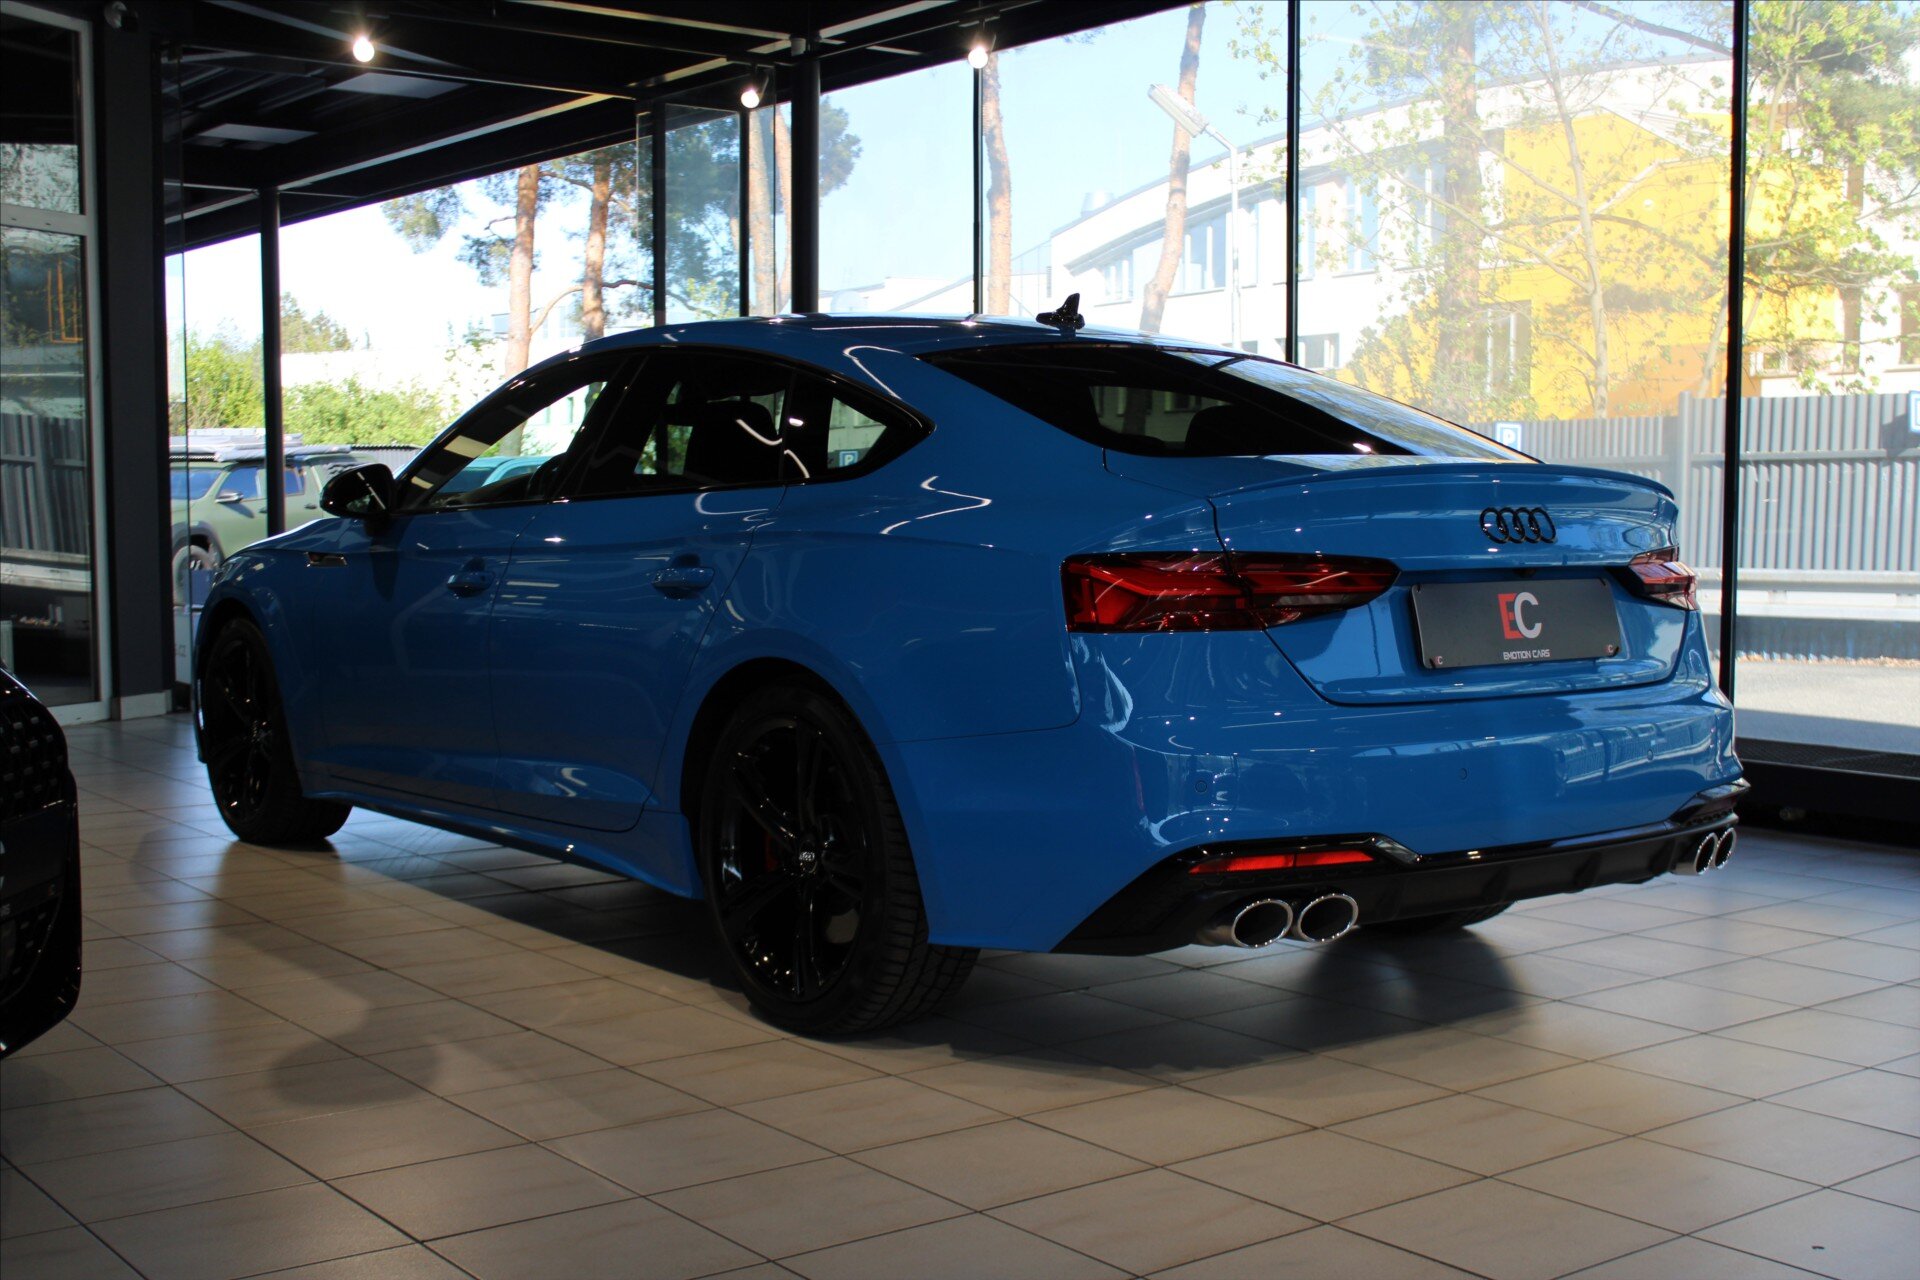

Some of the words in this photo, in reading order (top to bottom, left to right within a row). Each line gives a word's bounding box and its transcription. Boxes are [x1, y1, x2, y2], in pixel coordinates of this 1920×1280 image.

[1502, 428, 1516, 445] P
[844, 454, 854, 466] P
[1497, 591, 1543, 640] EC
[1503, 650, 1532, 660] EMOTION
[1532, 649, 1551, 658] CARS
